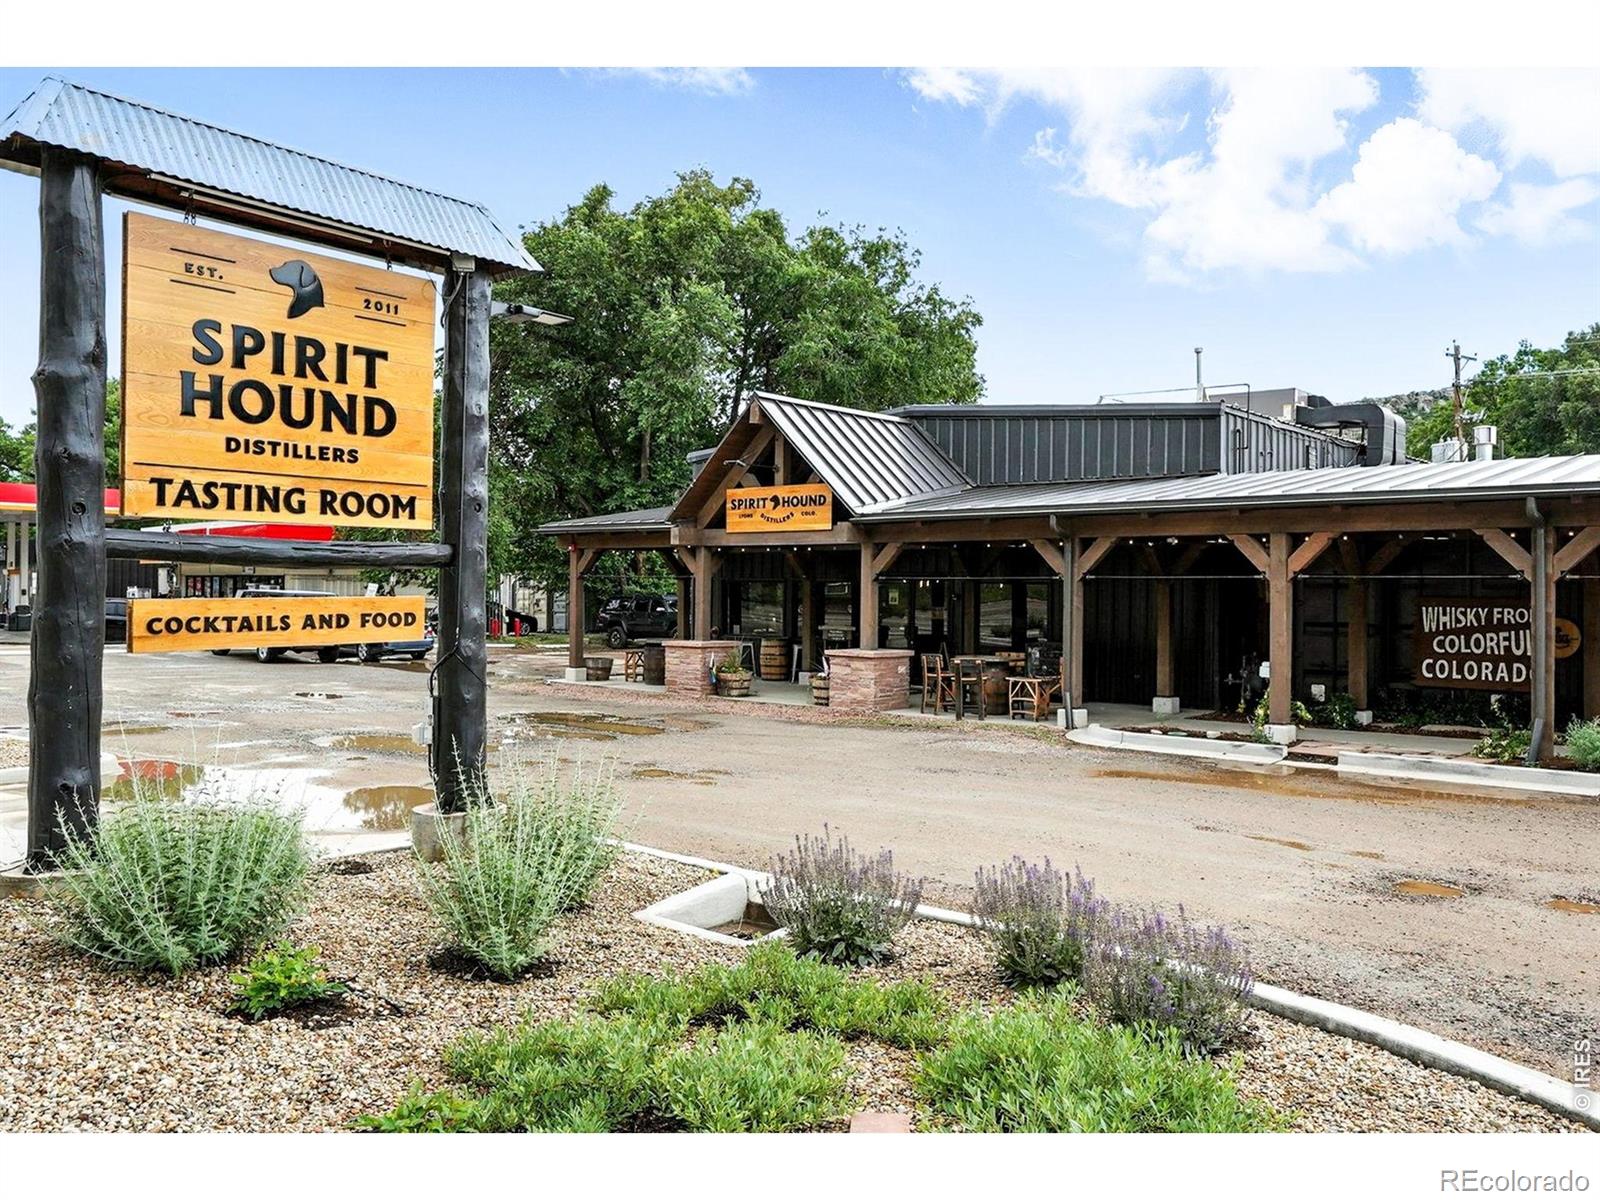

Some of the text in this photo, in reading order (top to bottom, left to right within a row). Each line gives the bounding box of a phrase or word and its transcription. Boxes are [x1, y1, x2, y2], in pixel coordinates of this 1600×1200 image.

[185, 261, 224, 280] EST.
[363, 299, 400, 316] 2011
[192, 318, 389, 389] SPIRIT
[180, 370, 397, 437] HOUND
[225, 436, 359, 464] DISTILLERS
[149, 477, 417, 520] TASTING ROOM
[730, 495, 827, 510] SPIRIT HOUND
[760, 511, 795, 524] DISTILLERS
[146, 611, 417, 636] COCKTAILS AND FOOD
[1421, 606, 1532, 633] WHISKY FRO
[1421, 658, 1532, 683] COLORAD
